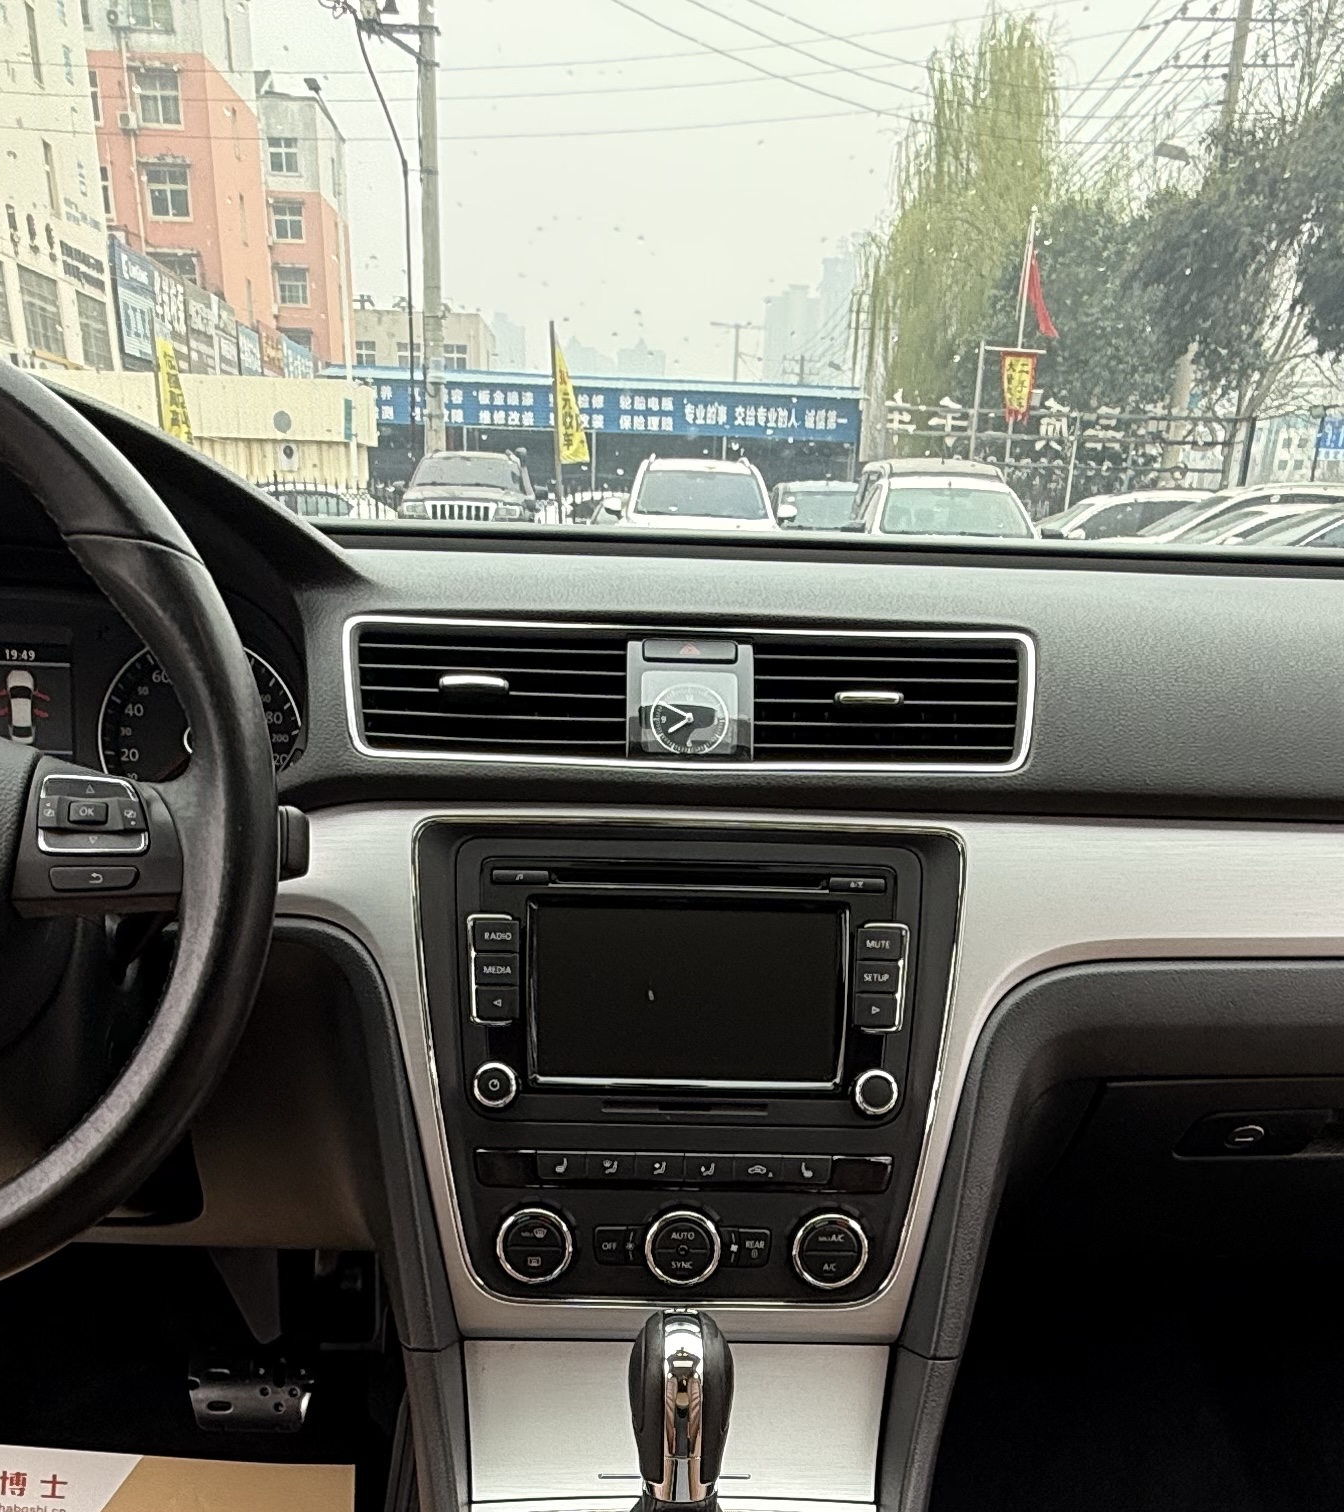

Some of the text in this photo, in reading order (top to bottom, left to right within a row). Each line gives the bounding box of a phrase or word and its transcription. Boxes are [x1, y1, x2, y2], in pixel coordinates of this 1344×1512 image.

[684, 402, 728, 425] 专业的事
[734, 404, 798, 428] 交给专业的人
[5, 648, 36, 661] 19:49
[124, 703, 144, 717] 40
[120, 749, 139, 762] 20
[78, 806, 95, 817] OK
[484, 932, 512, 941] RADIO
[865, 939, 891, 949] MUTE
[482, 965, 512, 974] MEDIA
[863, 972, 890, 982] SETUP
[671, 1231, 695, 1240] AUTO
[601, 1242, 617, 1251] OFF
[745, 1240, 765, 1249] REAR
[671, 1261, 693, 1269] SYNC
[822, 1263, 837, 1272] A/C
